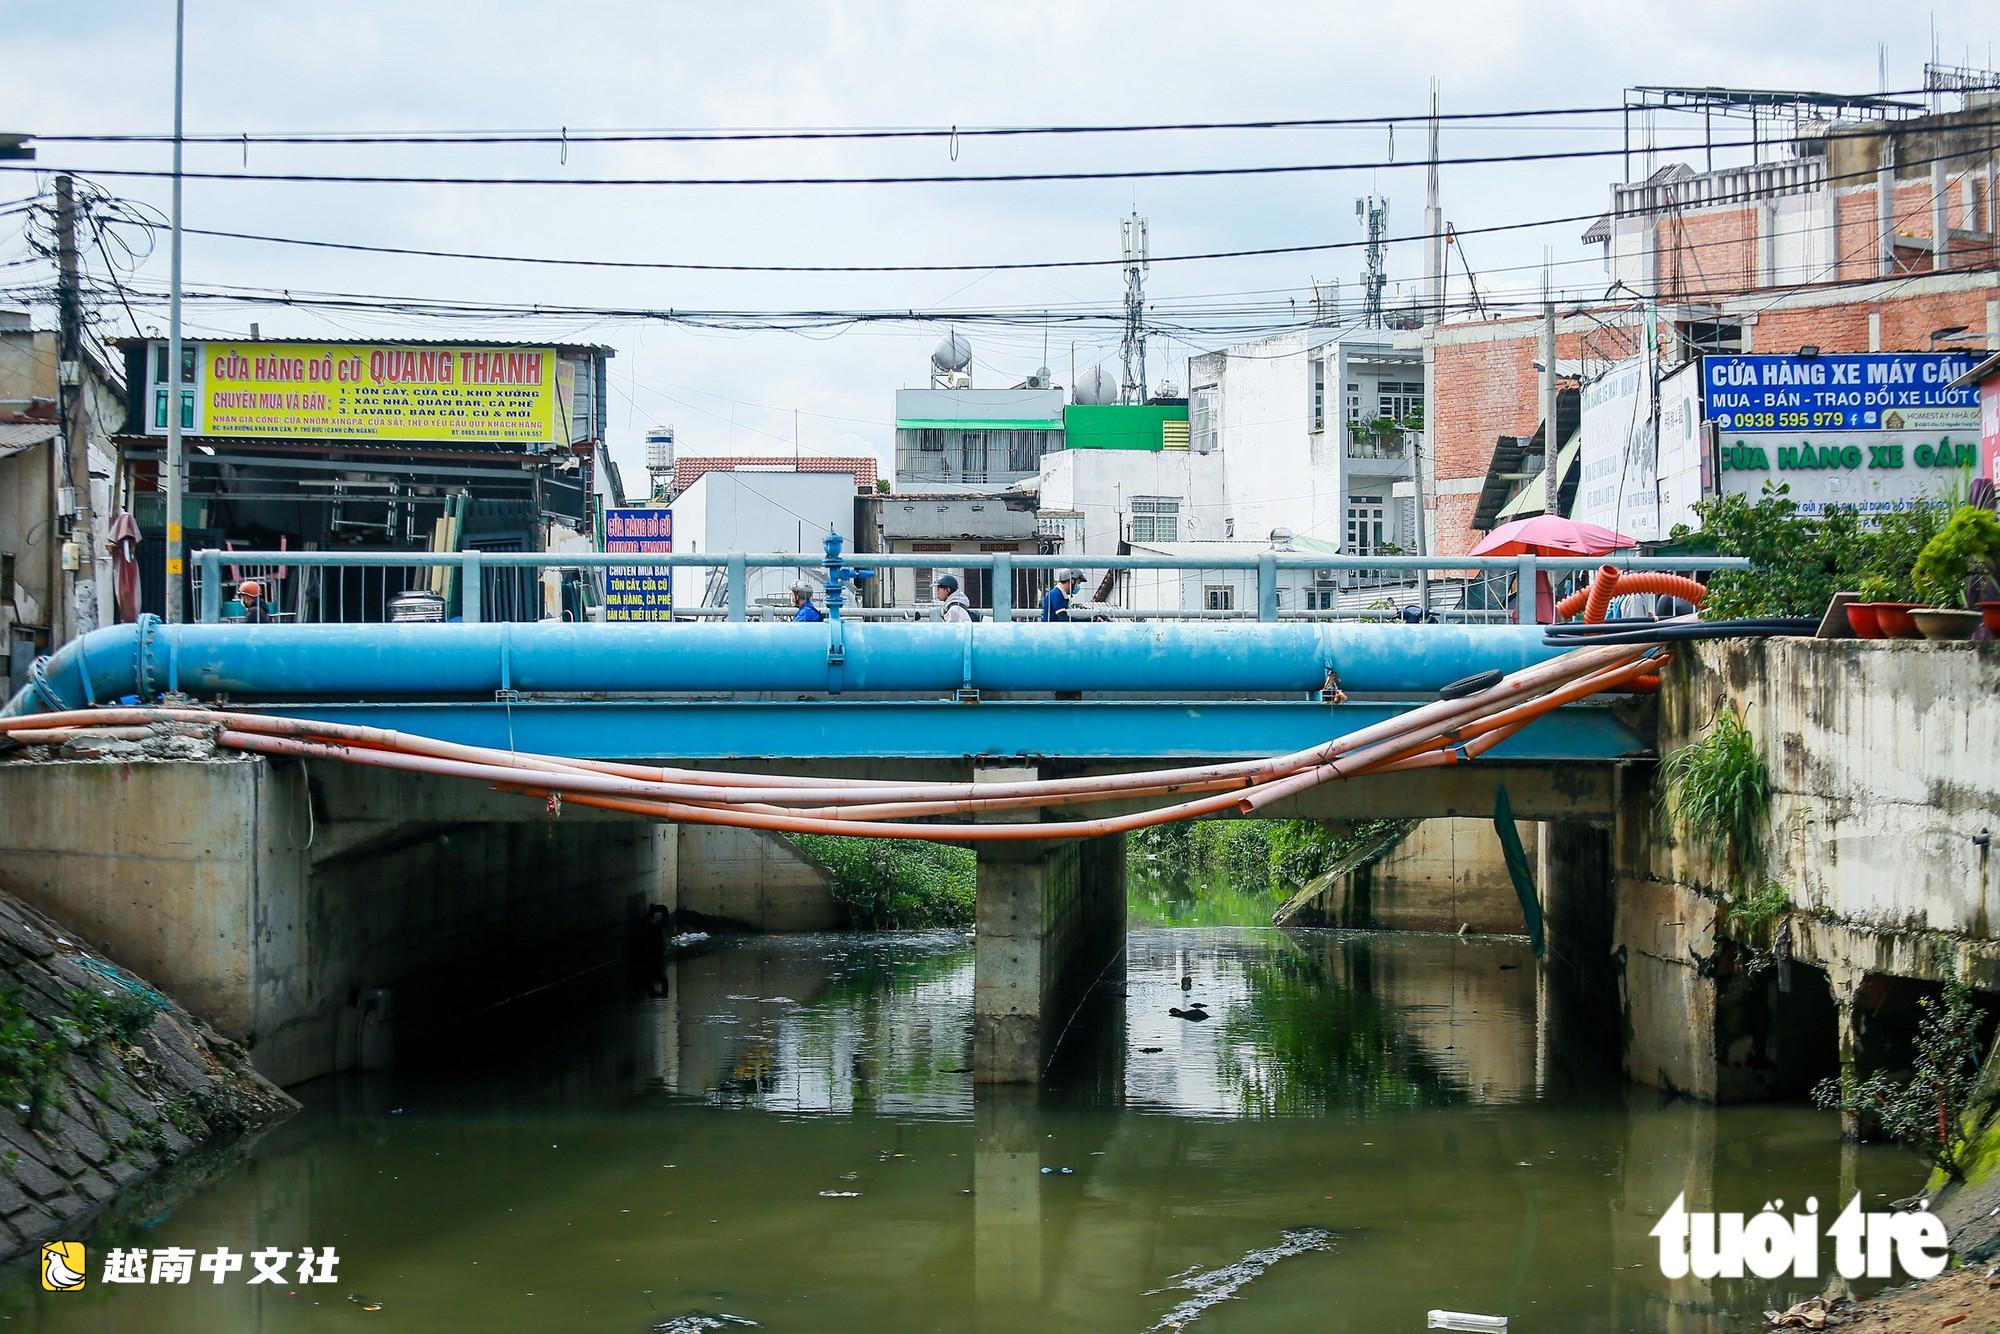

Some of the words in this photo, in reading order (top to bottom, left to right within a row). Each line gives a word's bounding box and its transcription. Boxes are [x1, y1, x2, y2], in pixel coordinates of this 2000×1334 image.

[214, 349, 250, 381] CỬA
[254, 352, 304, 383] HÀNG
[309, 351, 333, 383] ĐỒ
[370, 350, 453, 387] QUANG
[459, 352, 543, 386] THANH
[1712, 358, 1758, 386] CỬA
[1762, 360, 1826, 386] HÀNG
[1831, 362, 1861, 385] XE
[1867, 358, 1917, 385] MÁY
[354, 387, 379, 396] TÔN
[413, 388, 439, 397] CỬA
[1712, 393, 1751, 408] MUA
[1764, 389, 1800, 407] BÁN
[1813, 392, 1861, 407] TRAO
[1864, 384, 1894, 406] ĐỔI
[1898, 391, 1921, 405] XE
[1924, 386, 1970, 405] LƯỚT
[259, 393, 284, 410] MUA
[1734, 412, 1775, 428] 0938
[1779, 412, 1809, 427] 595
[1813, 412, 1844, 426] 979
[1721, 439, 1770, 471] CỬA
[1778, 441, 1863, 471] HÀNG
[1868, 444, 1904, 469] XE
[608, 512, 624, 537] CỬA
[625, 514, 647, 537] HÀNG
[647, 512, 659, 537] ĐỒ
[608, 541, 639, 553] QUANG
[640, 541, 671, 553] THANH
[637, 566, 654, 576] MUA
[611, 578, 625, 590] TÔN
[606, 592, 622, 605] NHÀ
[646, 592, 656, 605] CÀ
